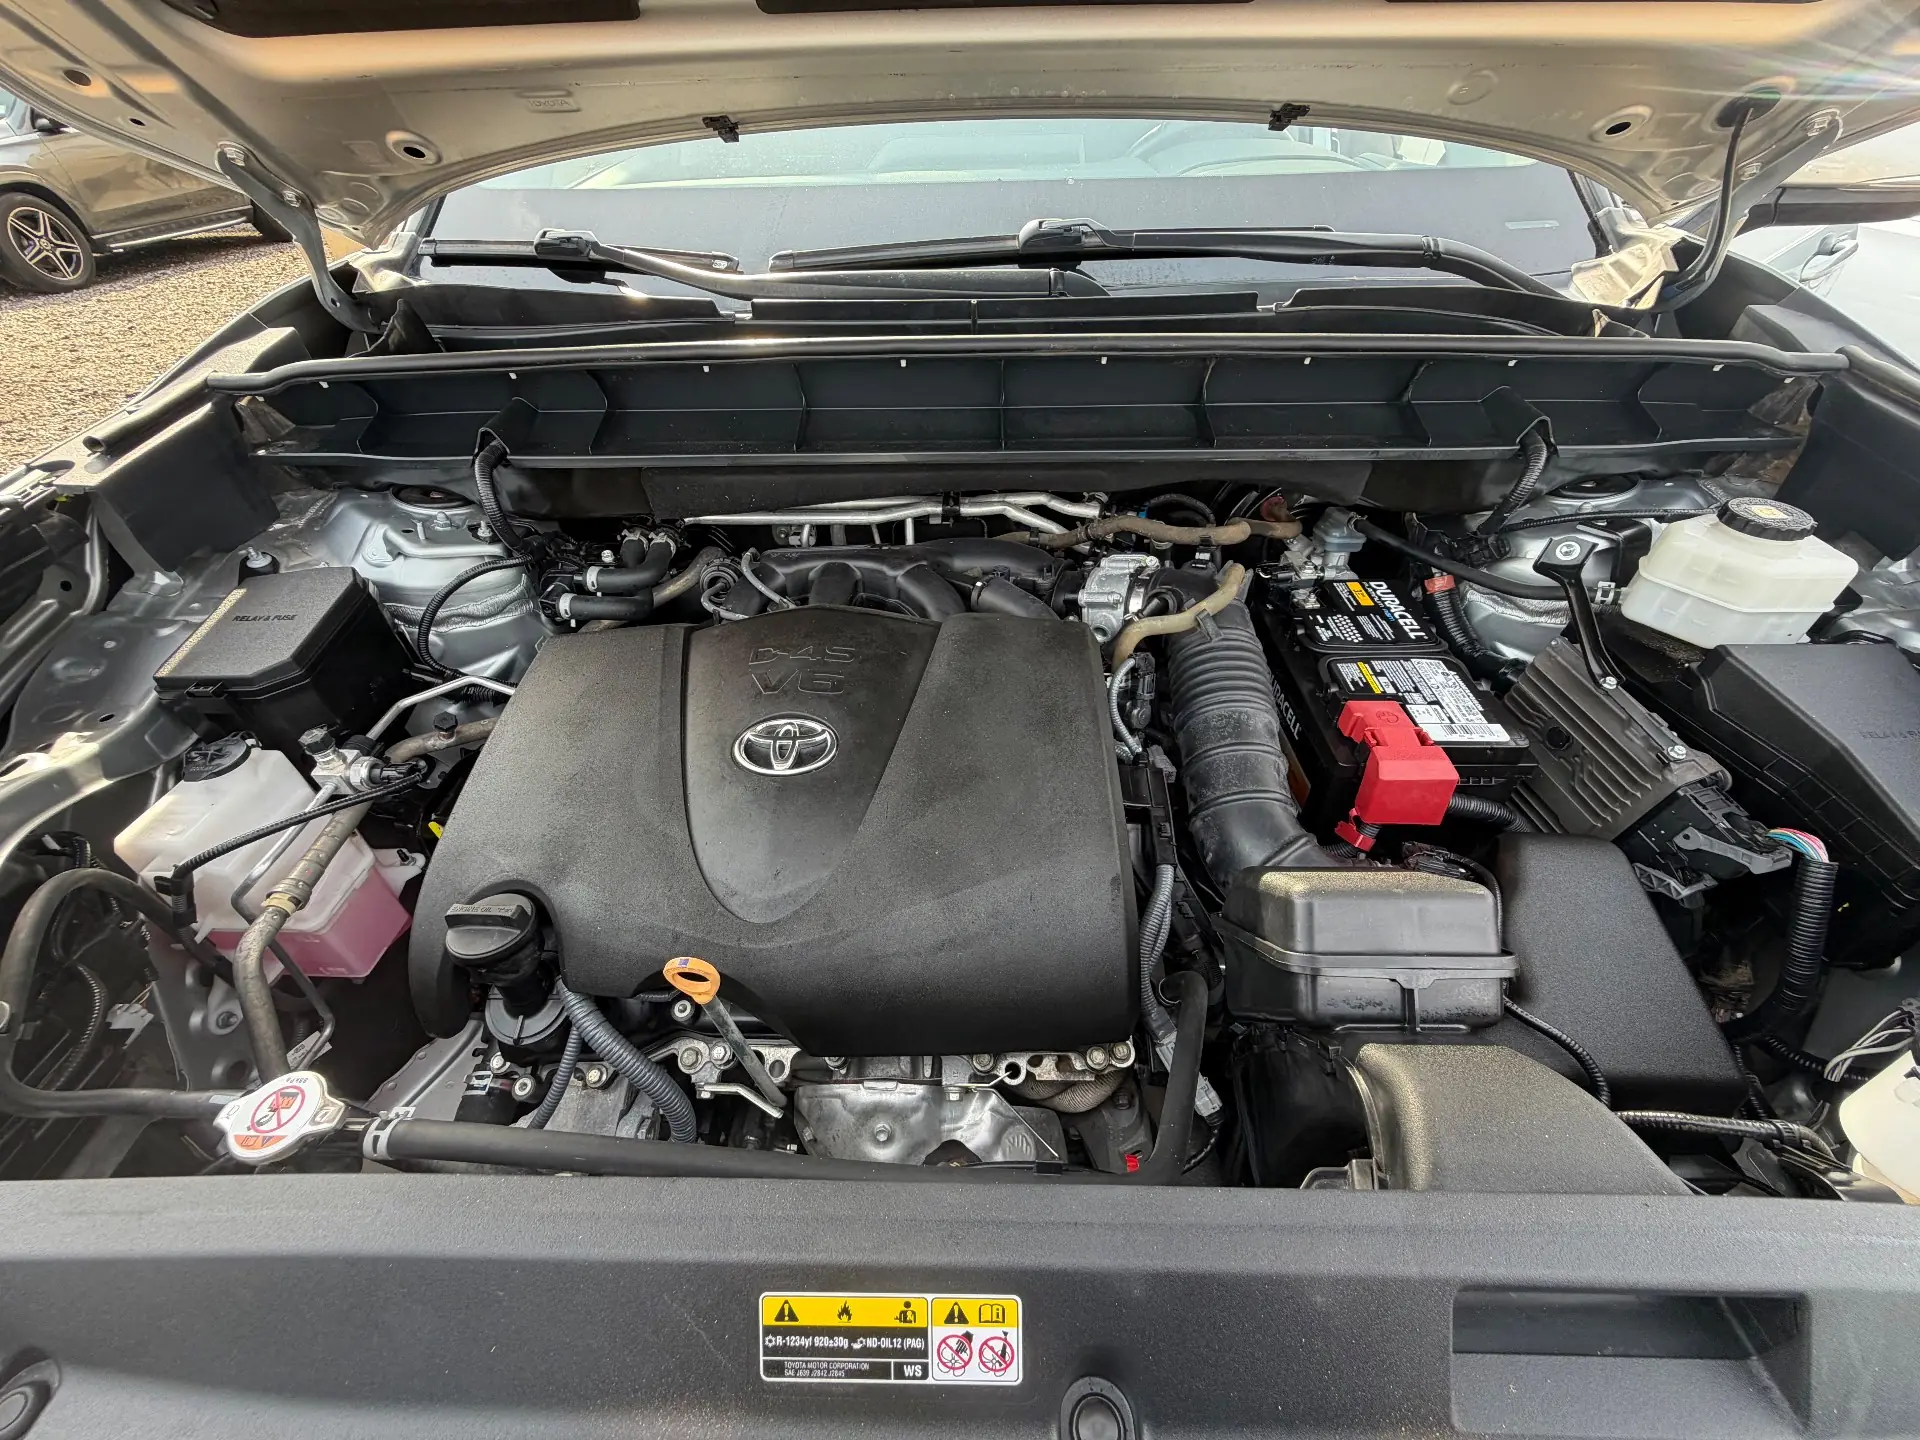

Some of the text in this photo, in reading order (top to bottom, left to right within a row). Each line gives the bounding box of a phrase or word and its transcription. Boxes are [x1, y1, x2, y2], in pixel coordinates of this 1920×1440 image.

[1369, 581, 1427, 640] DURACELL
[751, 669, 845, 694] V6
[776, 1335, 925, 1350] R-1234yf 920±30g ND-OIL12 (PAG)
[784, 1361, 870, 1370] TOYOTA MOTOR CORPORATION
[903, 1364, 923, 1377] WS
[796, 1369, 810, 1377] J639
